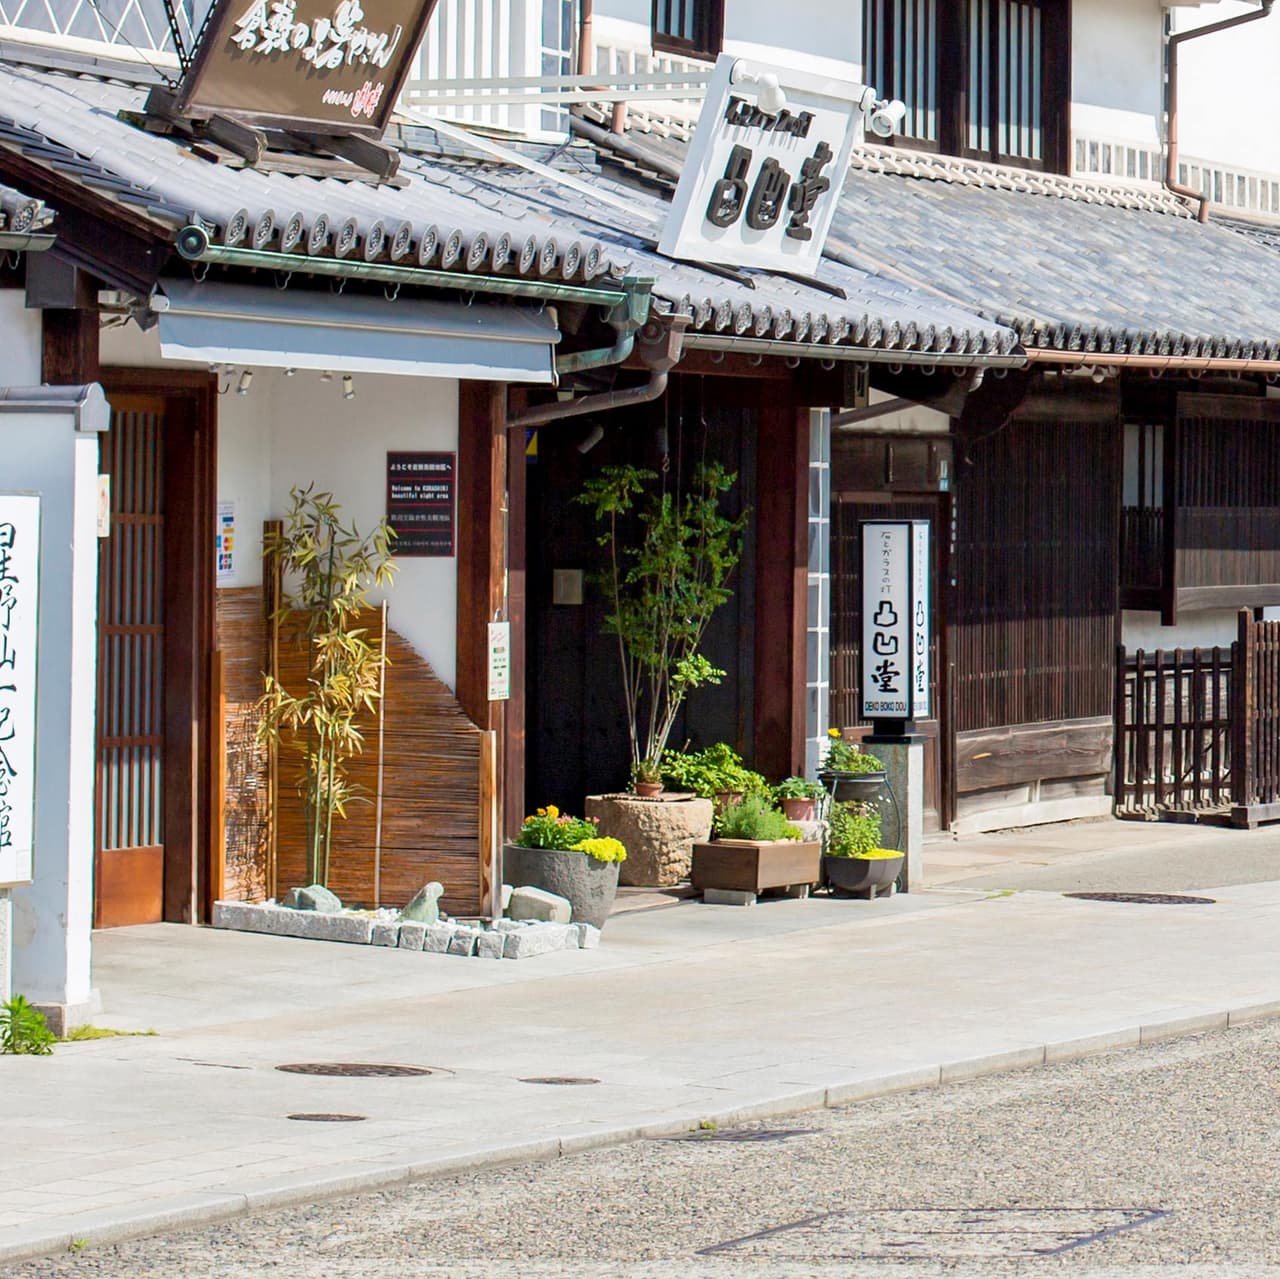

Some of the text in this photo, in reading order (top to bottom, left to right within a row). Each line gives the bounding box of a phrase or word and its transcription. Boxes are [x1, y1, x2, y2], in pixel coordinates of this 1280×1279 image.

[871, 600, 900, 693] 凸凹堂
[865, 701, 879, 711] DEKO
[880, 701, 895, 711] BOKO
[896, 701, 907, 711] DOU
